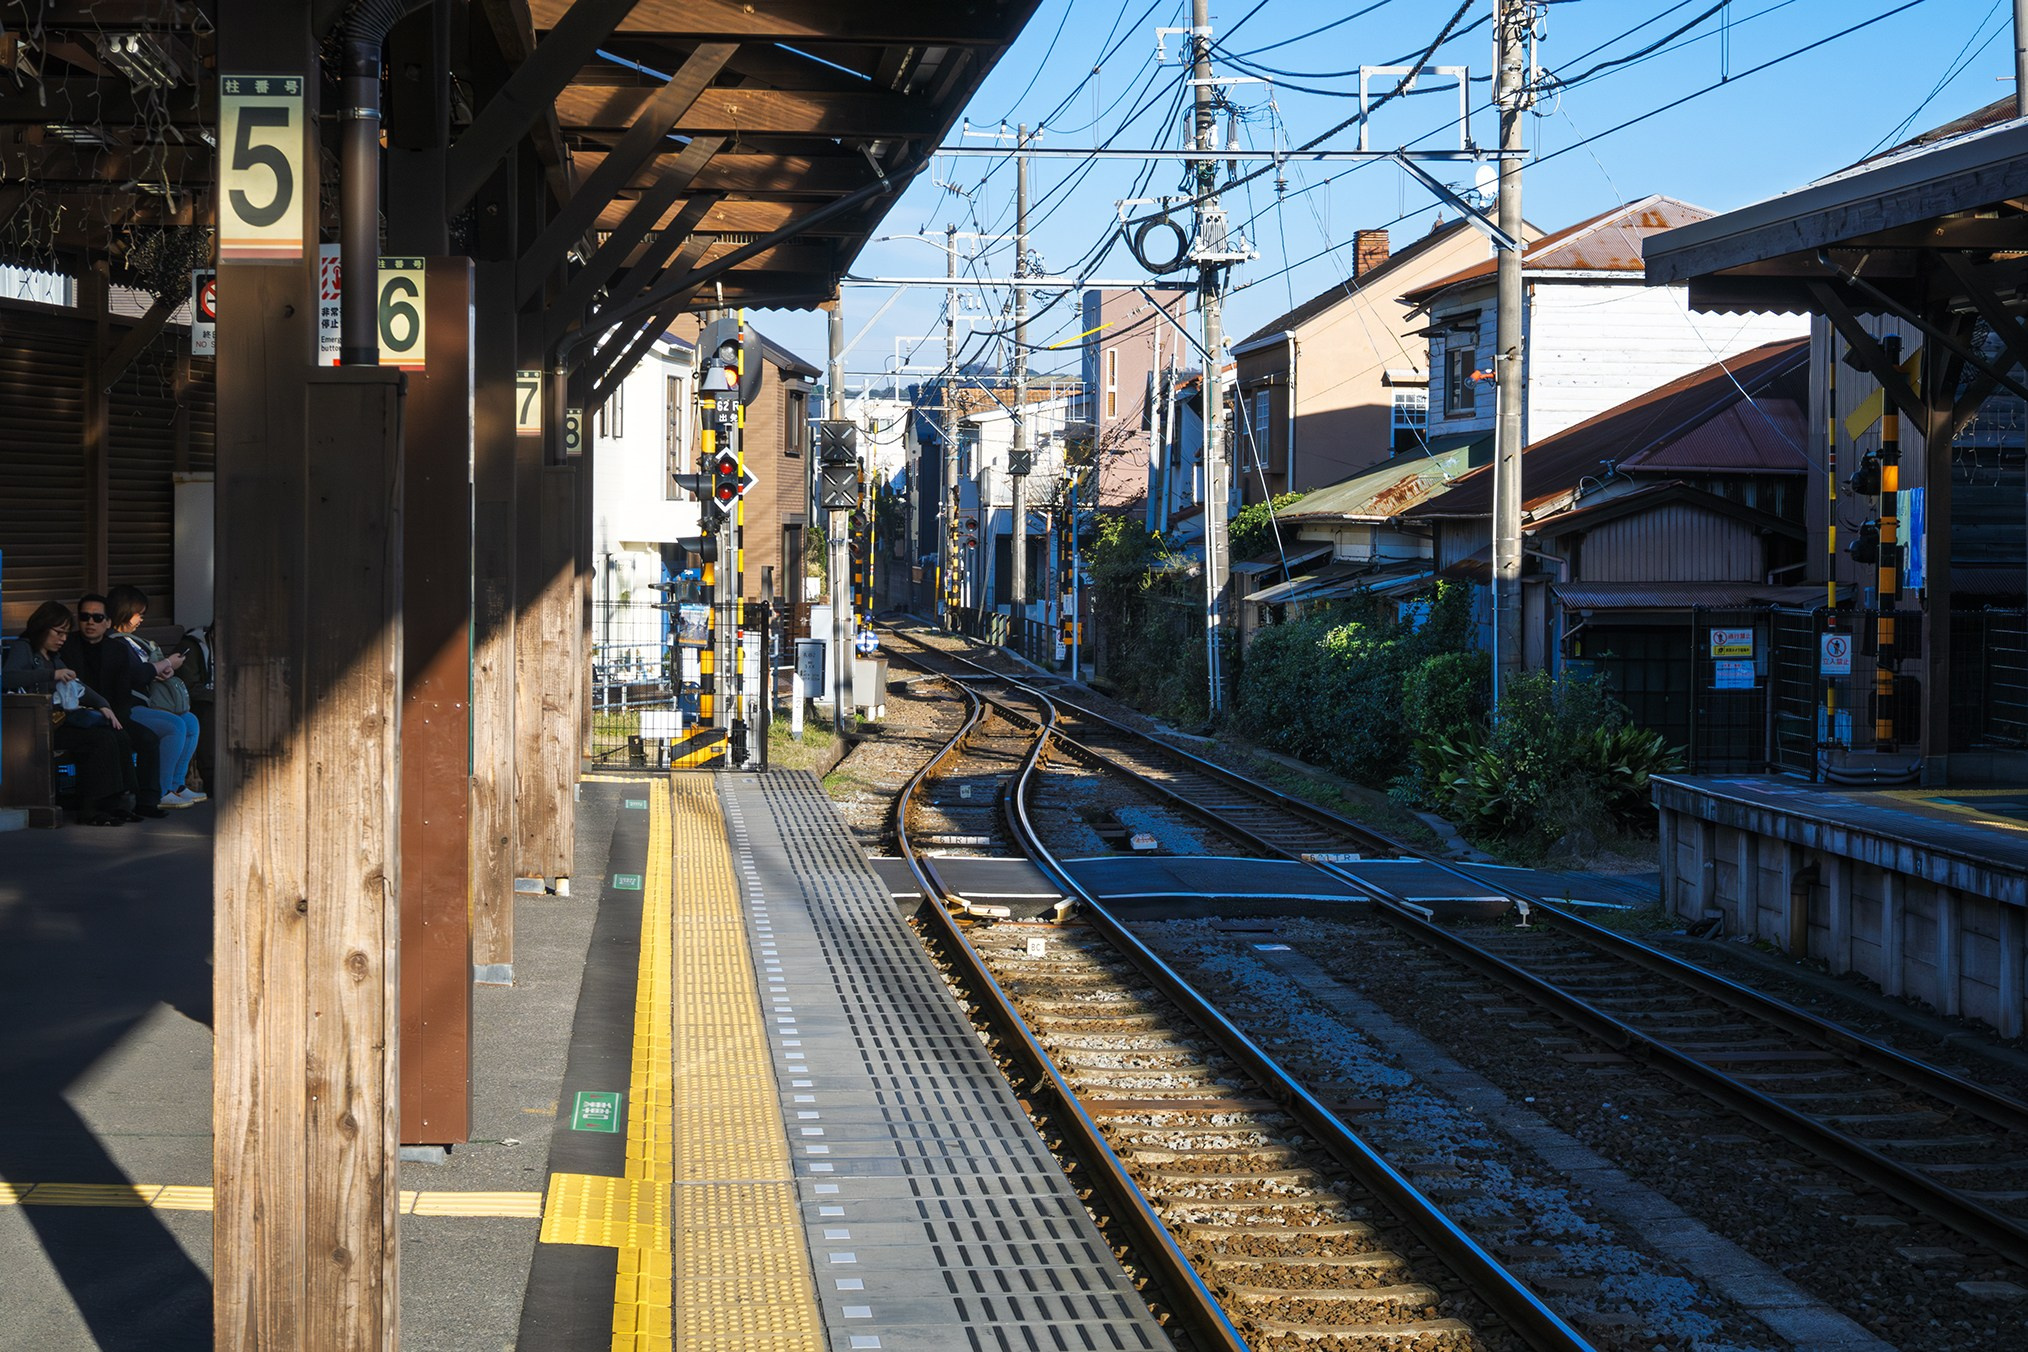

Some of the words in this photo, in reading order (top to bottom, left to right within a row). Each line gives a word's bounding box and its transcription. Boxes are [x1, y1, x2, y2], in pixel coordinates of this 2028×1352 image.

[226, 80, 299, 94] 柱番号
[228, 106, 294, 228] 5
[321, 307, 341, 317] 非常
[380, 276, 420, 353] 6
[516, 382, 538, 425] 7
[717, 401, 729, 411] 62
[732, 401, 740, 411] R
[566, 417, 580, 448] 8
